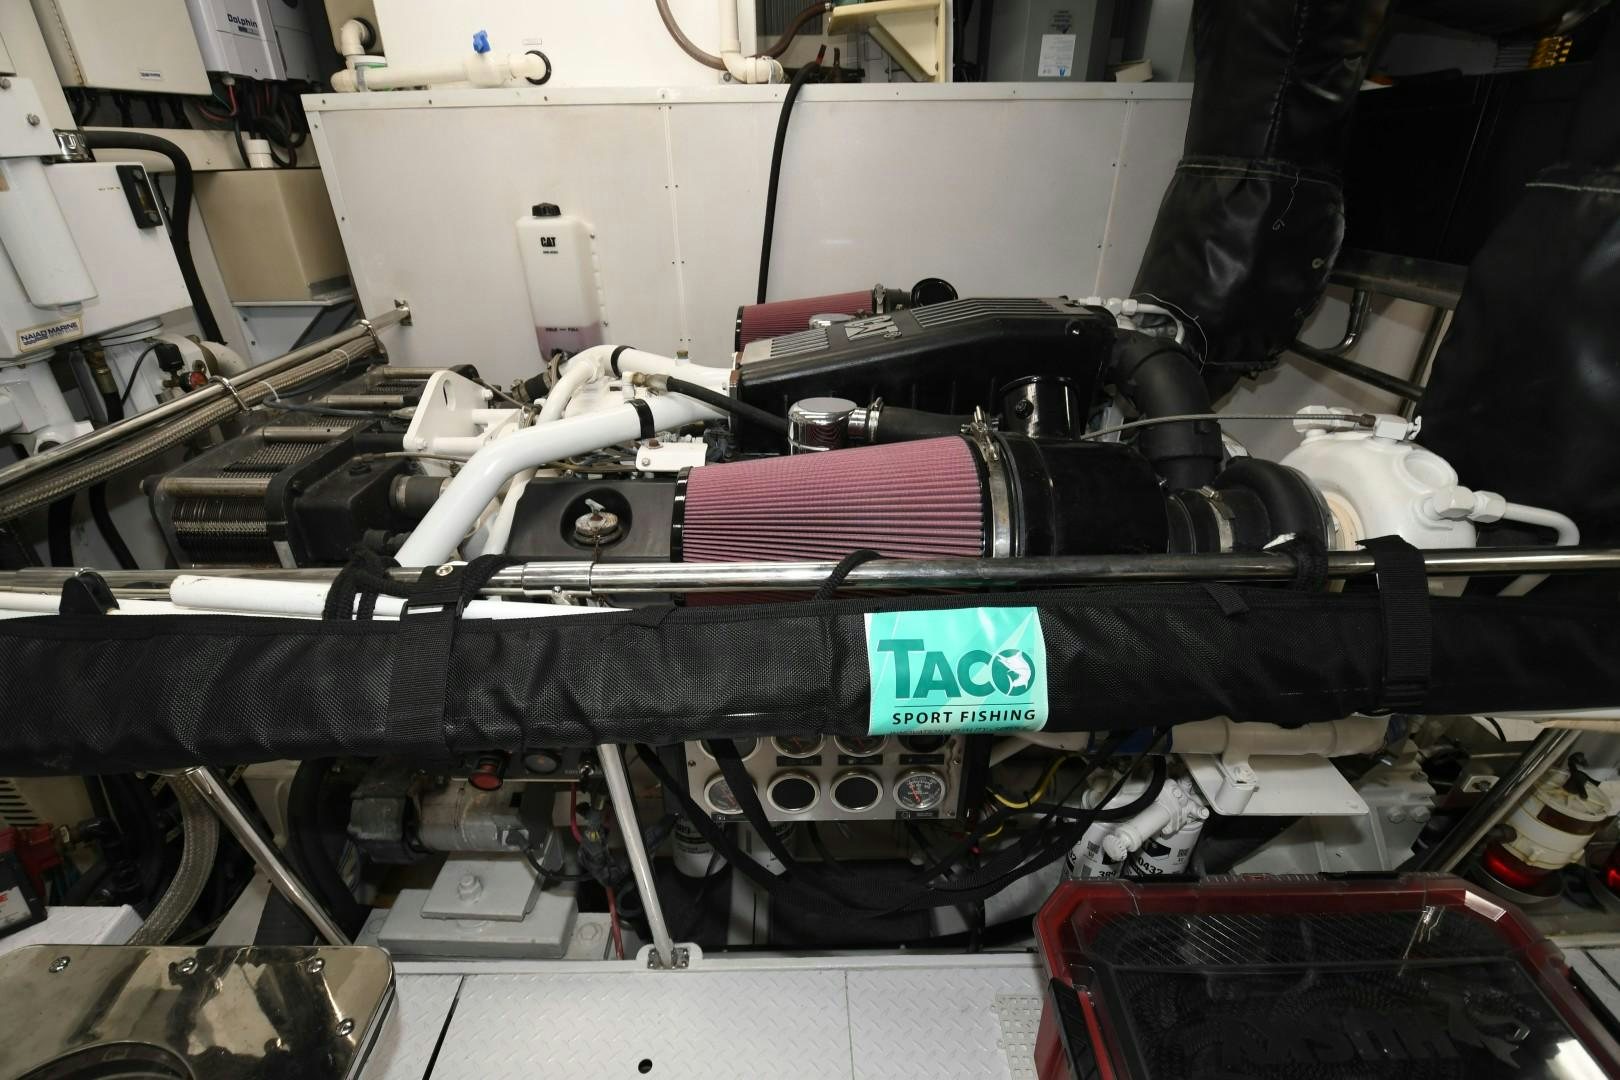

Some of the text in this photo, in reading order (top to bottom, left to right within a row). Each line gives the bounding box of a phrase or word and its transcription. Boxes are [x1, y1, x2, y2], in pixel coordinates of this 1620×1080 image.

[227, 13, 258, 28] Dolphin
[540, 236, 556, 247] CAT
[21, 329, 48, 342] NAIAD
[47, 321, 78, 335] MARINE
[877, 639, 1036, 699] TACO
[892, 709, 1036, 725] SPORT FISHING
